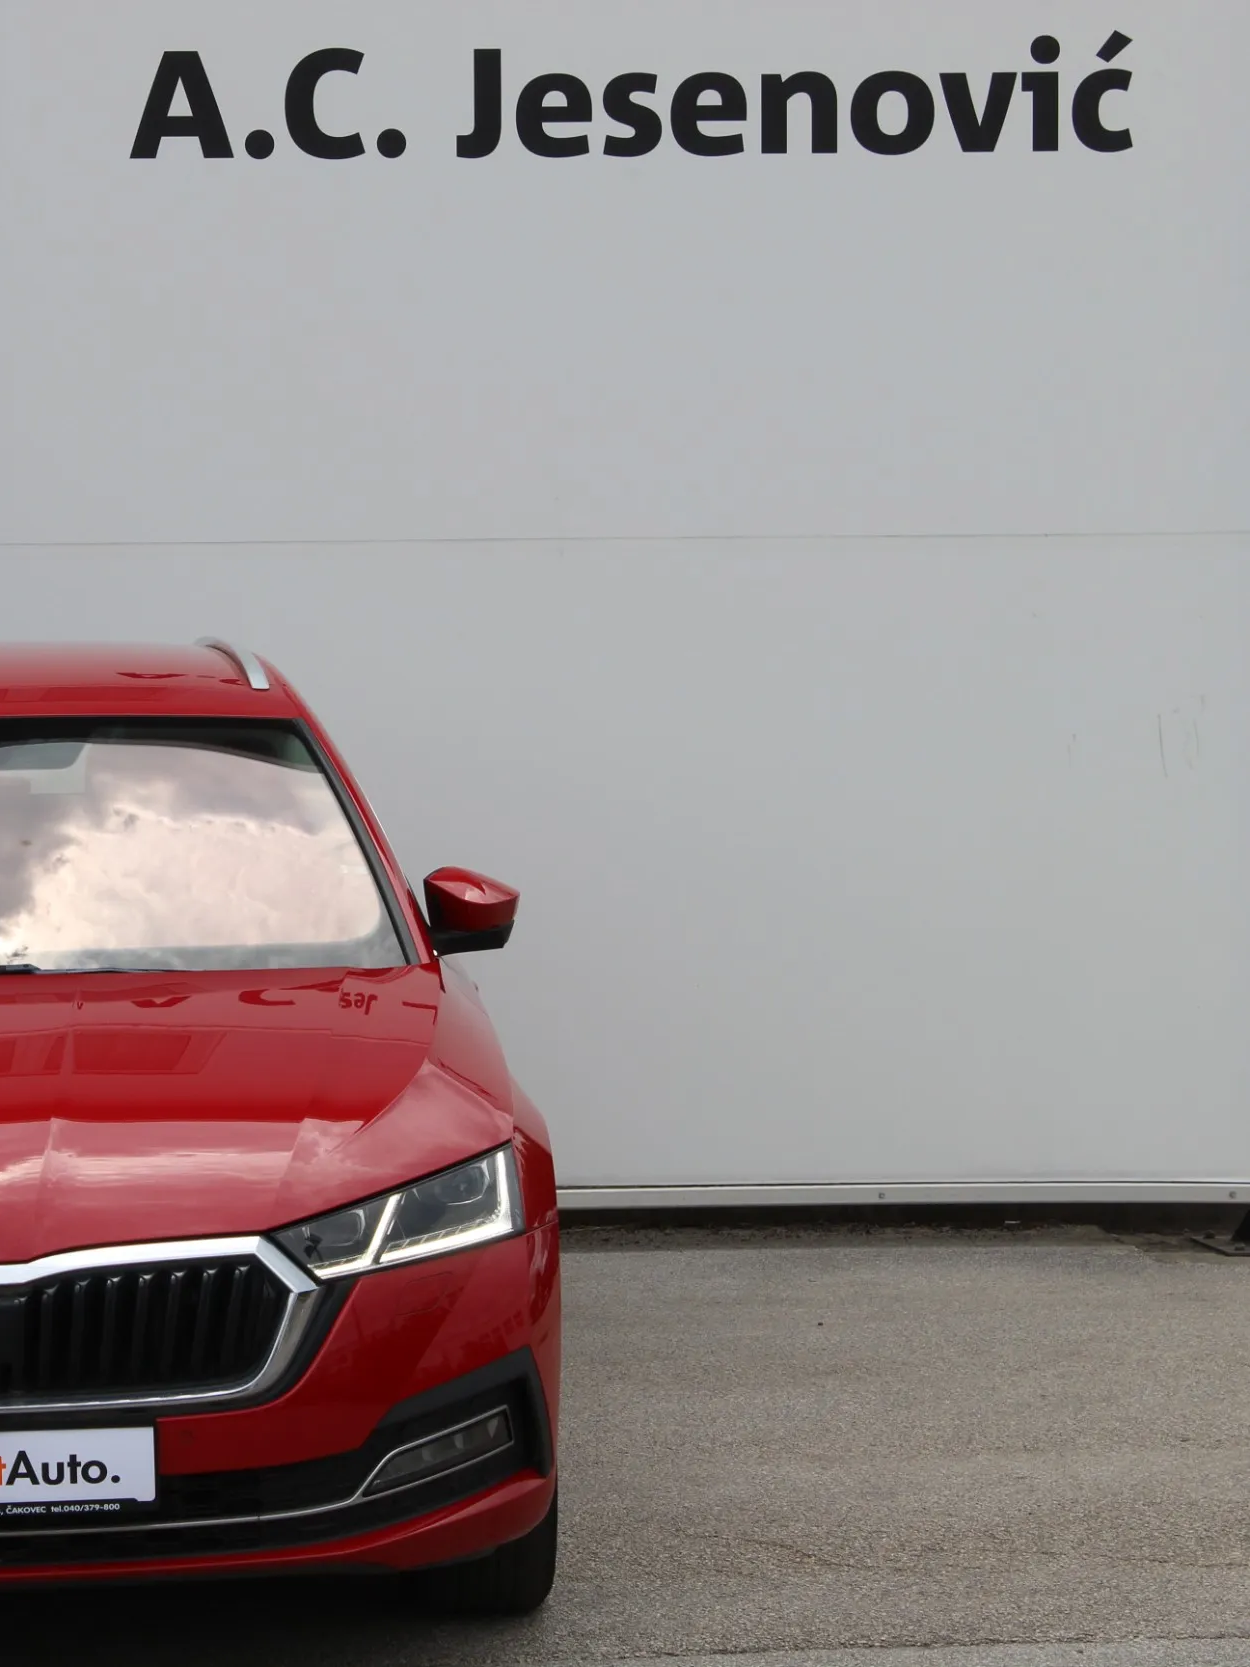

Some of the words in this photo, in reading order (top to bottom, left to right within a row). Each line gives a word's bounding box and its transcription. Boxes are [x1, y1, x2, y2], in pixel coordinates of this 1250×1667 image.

[130, 47, 407, 160] A.C.
[457, 30, 1134, 159] Jesenović
[6, 1504, 47, 1515] ČAKOVEC
